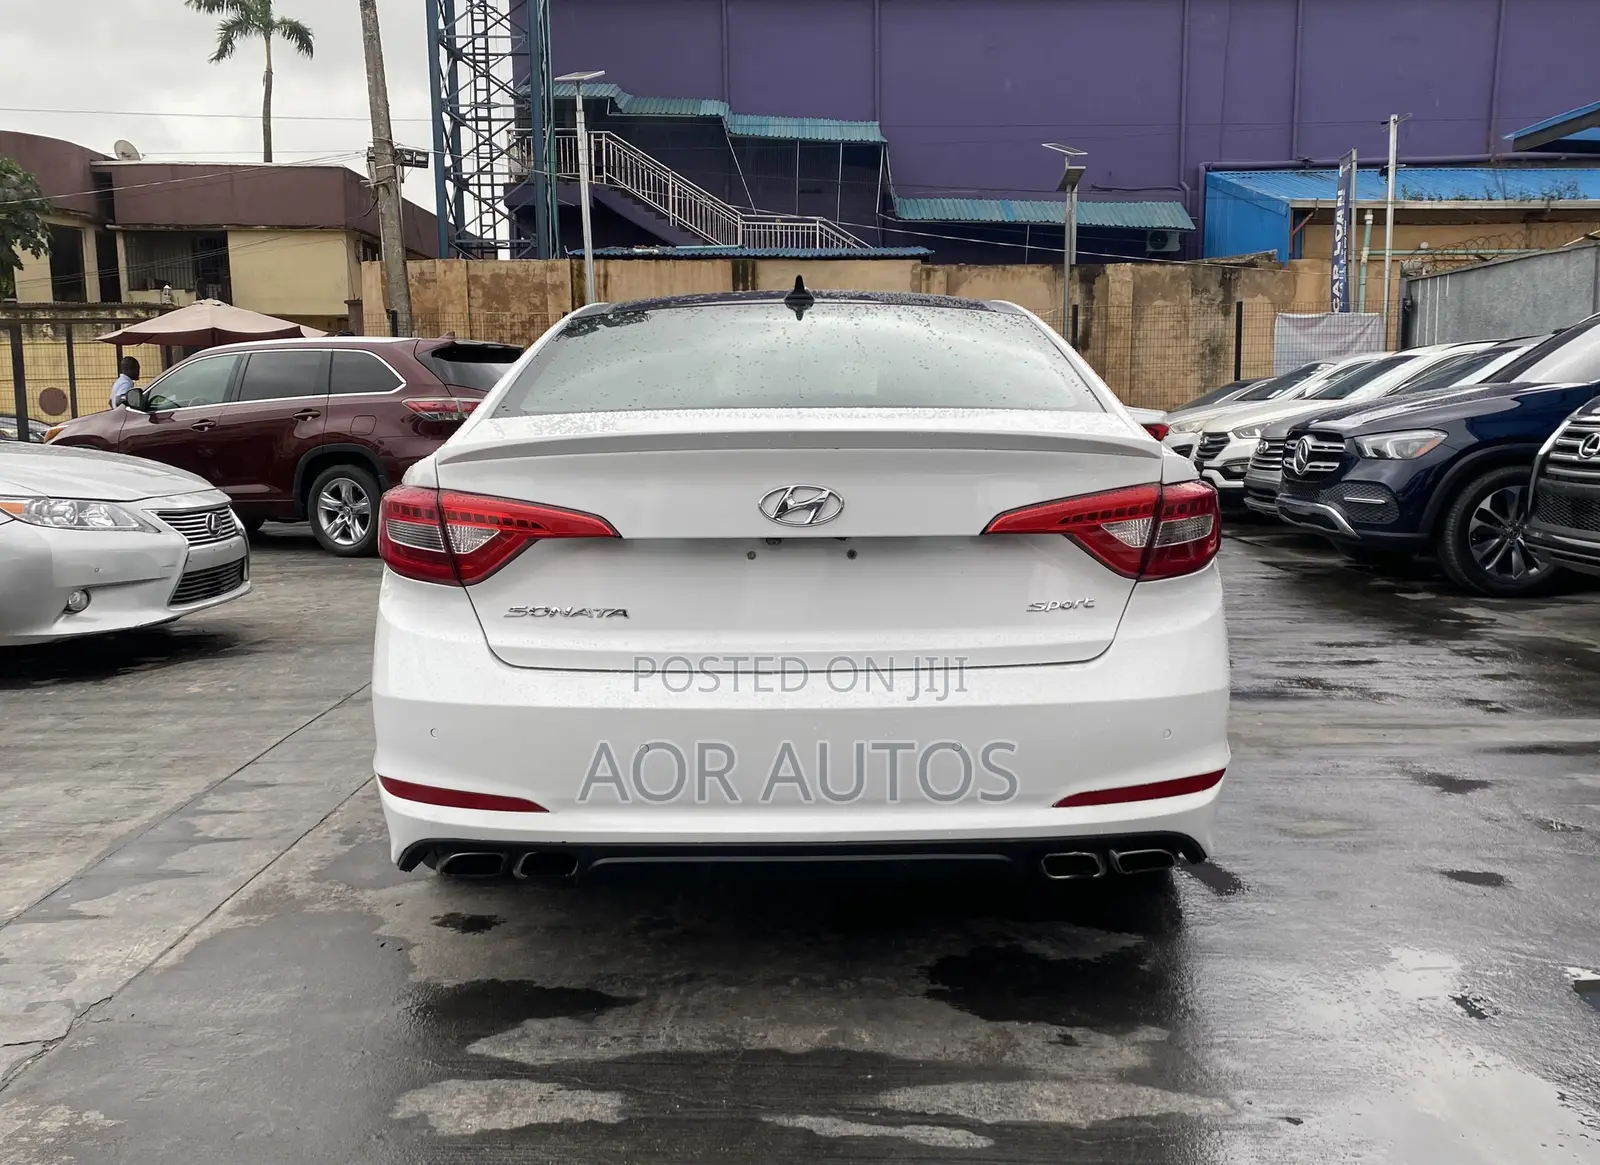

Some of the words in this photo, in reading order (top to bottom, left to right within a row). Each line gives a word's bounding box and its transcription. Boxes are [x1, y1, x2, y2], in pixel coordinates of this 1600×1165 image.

[1333, 188, 1346, 257] LOAN
[1332, 264, 1340, 313] CAR
[503, 605, 630, 619] SONATA
